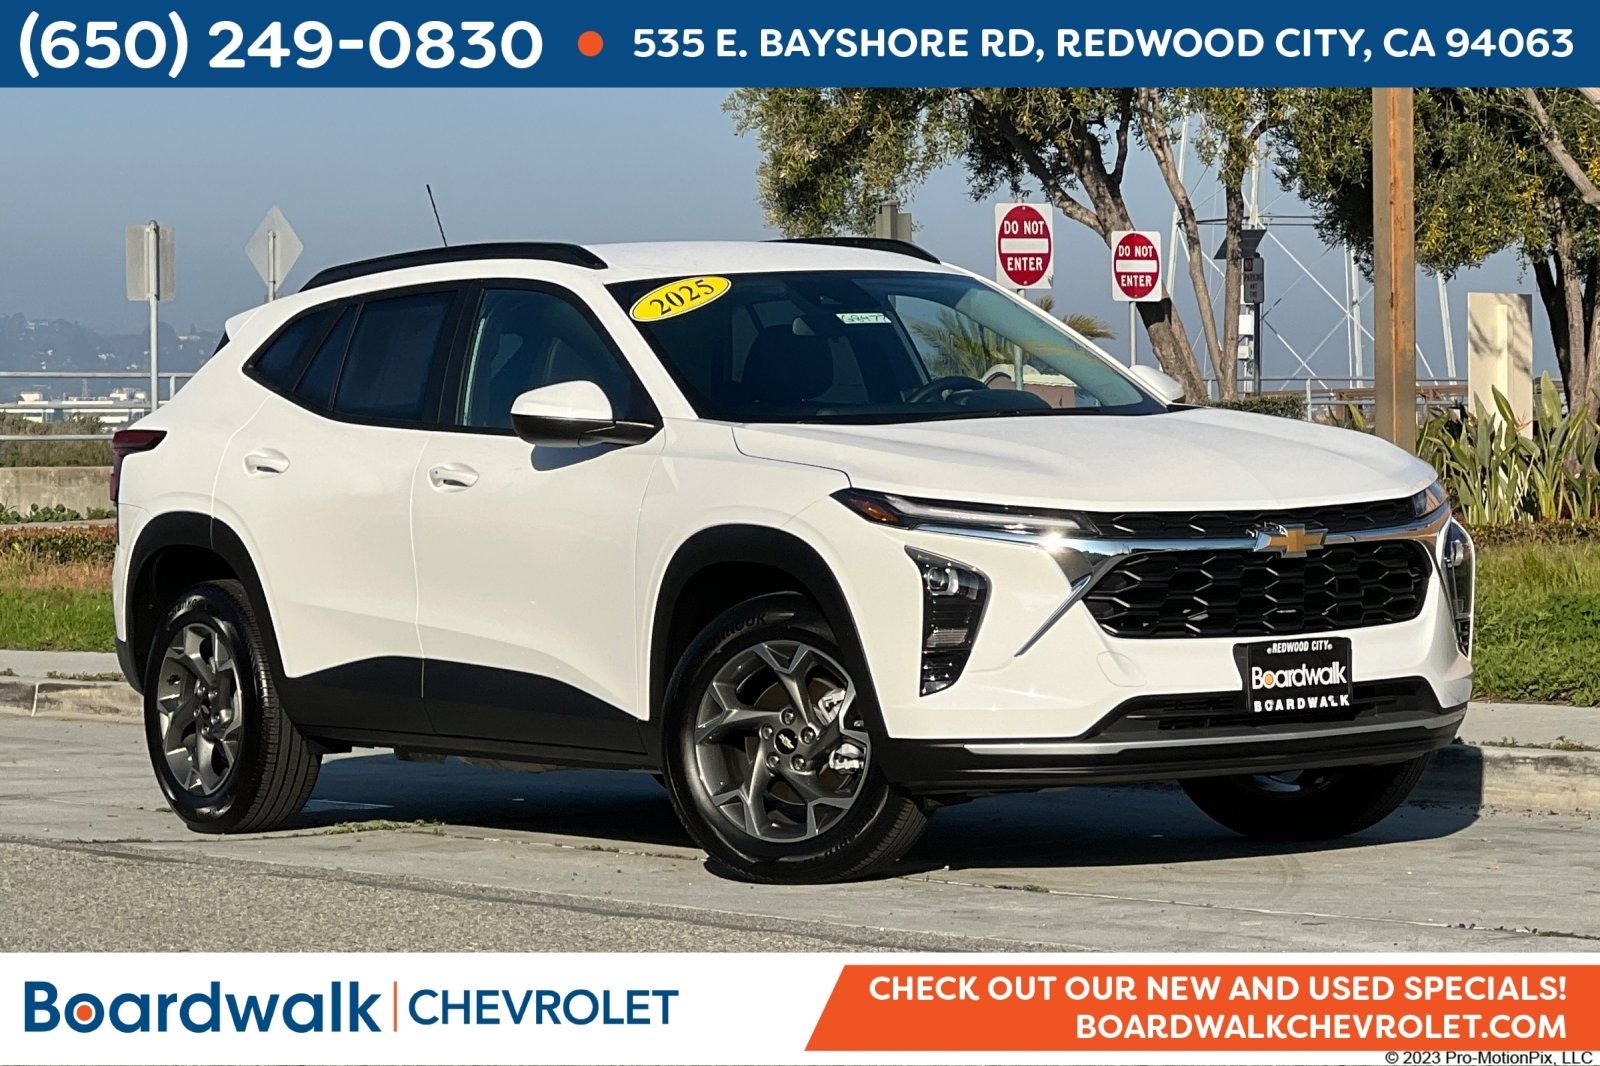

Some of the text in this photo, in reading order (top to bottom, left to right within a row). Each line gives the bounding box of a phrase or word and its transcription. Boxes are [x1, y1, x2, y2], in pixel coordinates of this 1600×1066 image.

[1004, 221, 1045, 234] DO NOT
[1118, 245, 1153, 257] DO NOT
[1007, 257, 1043, 271] ENTER
[1121, 275, 1152, 287] ENTER
[649, 279, 714, 315] 2025
[1272, 640, 1329, 653] REDWOOD CITY
[1252, 662, 1347, 689] Boardwalk
[1254, 695, 1349, 712] BOARDWALK
